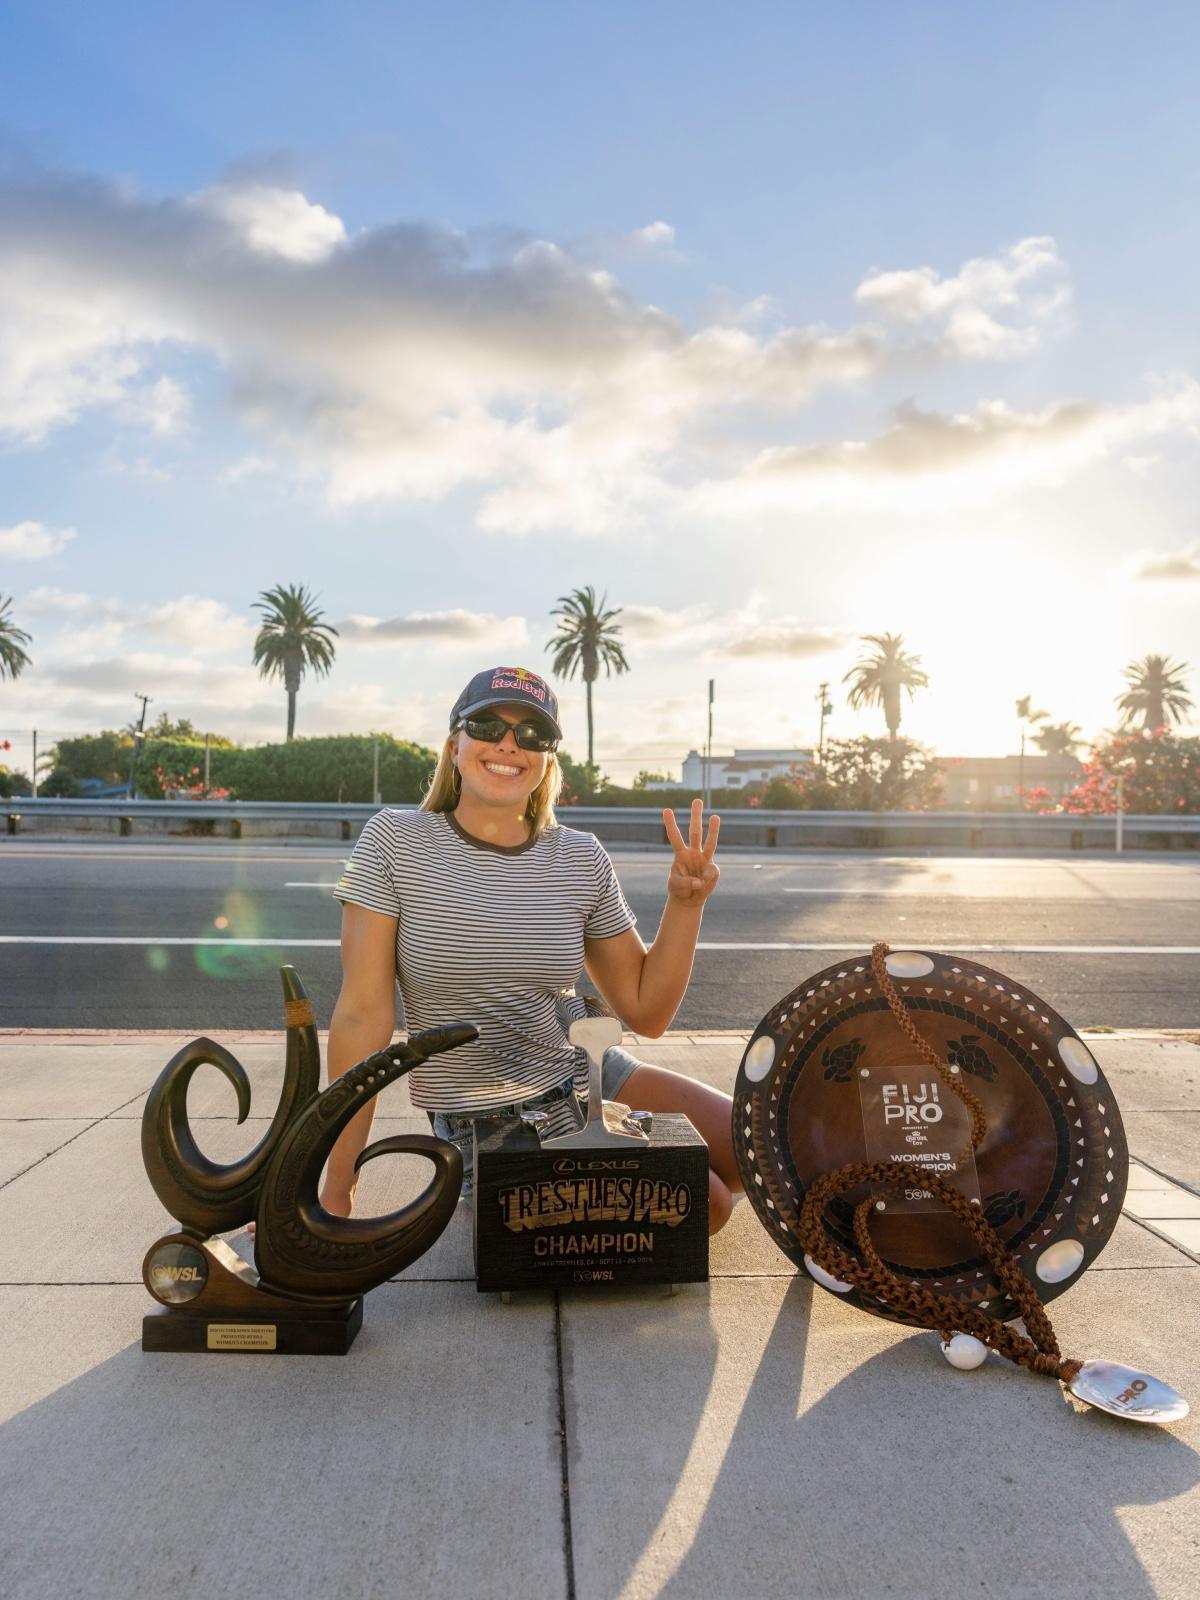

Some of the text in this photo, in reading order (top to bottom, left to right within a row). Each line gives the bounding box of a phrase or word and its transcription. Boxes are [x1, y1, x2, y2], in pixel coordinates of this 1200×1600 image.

[492, 678, 545, 702] Red Bull
[883, 1083, 939, 1104] FIJI
[885, 1103, 943, 1124] PRO
[578, 1160, 640, 1171] LEXUS
[891, 1153, 951, 1162] WOMEN'S
[534, 1232, 654, 1256] CHAMPION
[167, 1266, 202, 1281] WSL
[592, 1270, 615, 1281] WSL
